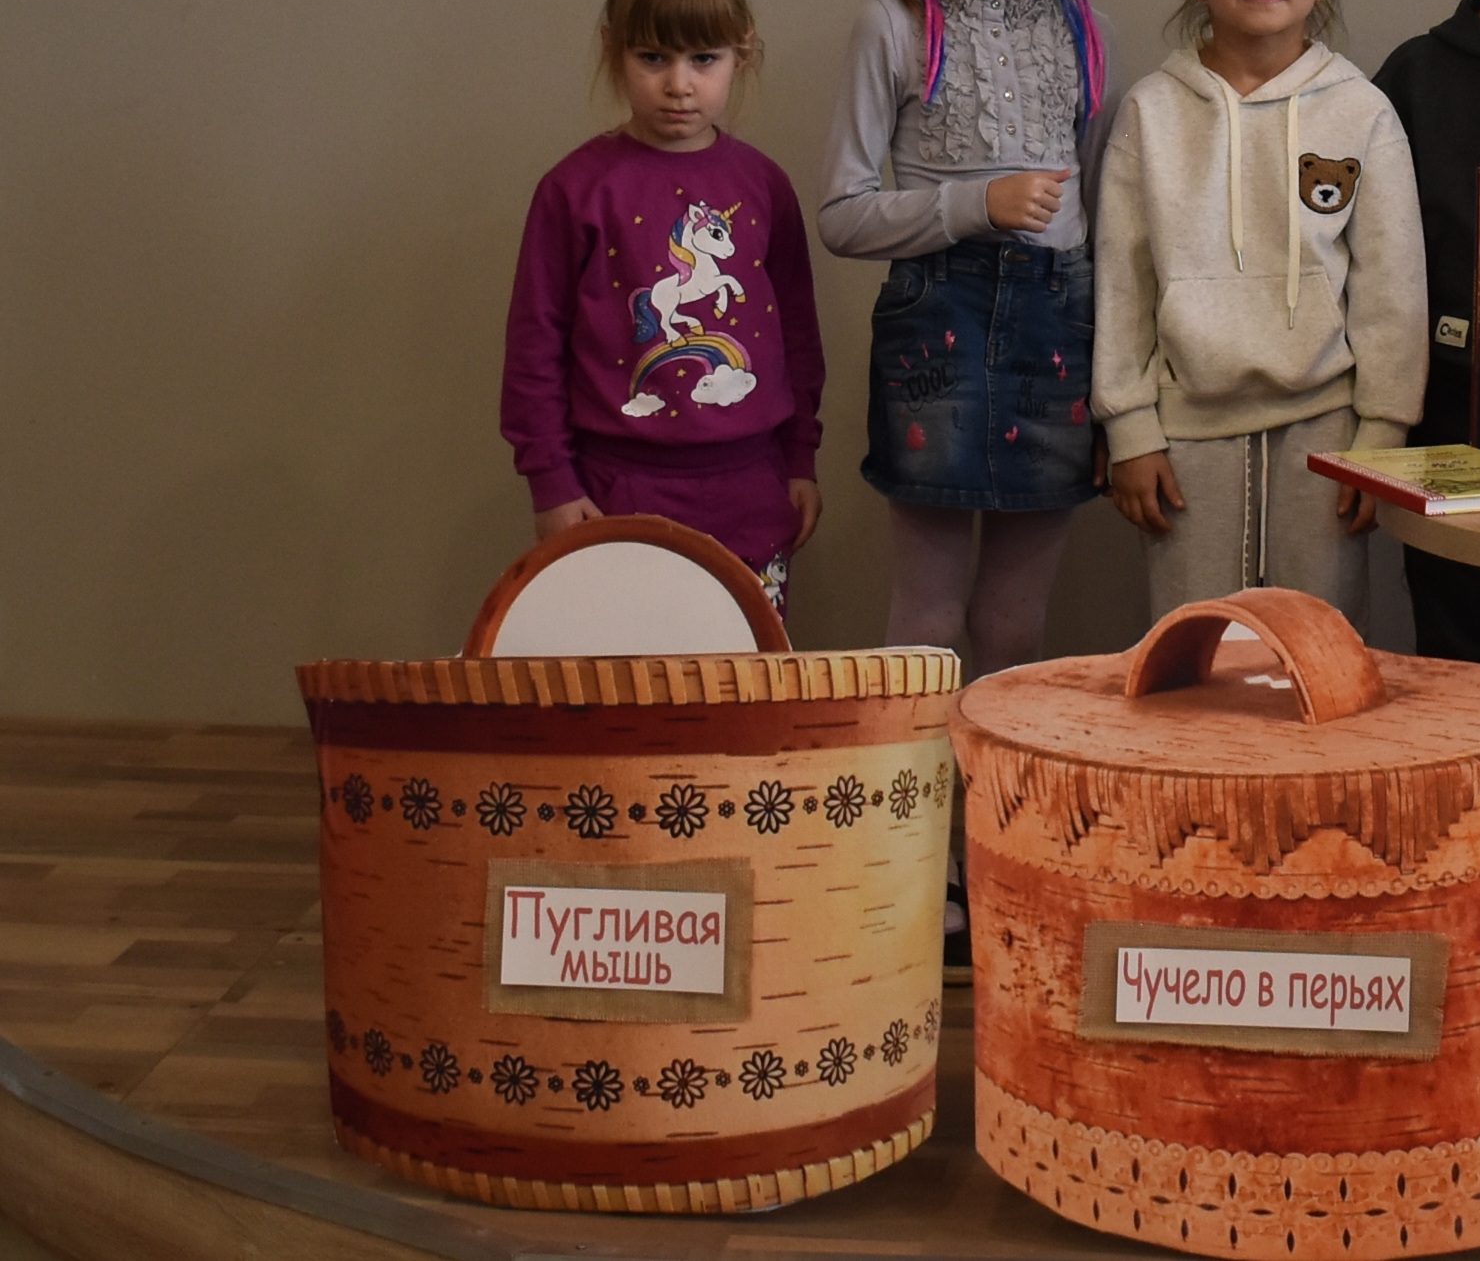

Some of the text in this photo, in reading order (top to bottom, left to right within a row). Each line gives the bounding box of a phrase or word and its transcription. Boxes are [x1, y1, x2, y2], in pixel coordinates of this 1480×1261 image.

[907, 364, 954, 401] COOL
[507, 890, 720, 956] Пугливая
[561, 950, 672, 985] мышь
[1123, 951, 1406, 1026] Чучело в перьях
